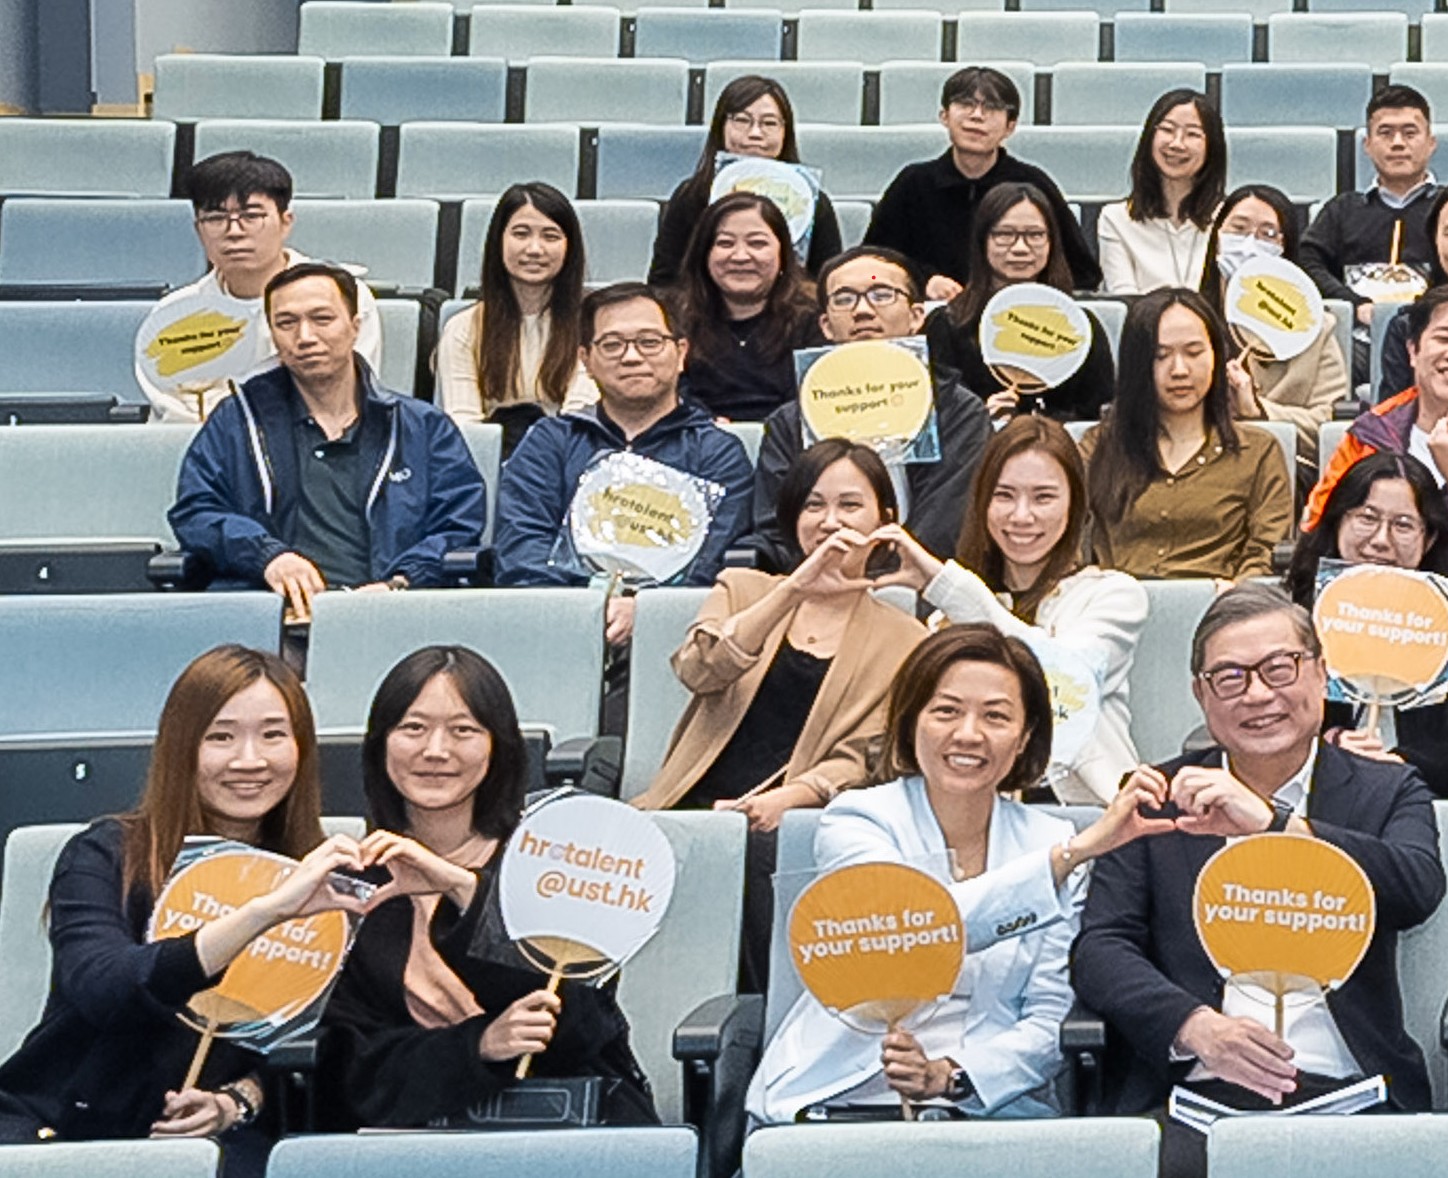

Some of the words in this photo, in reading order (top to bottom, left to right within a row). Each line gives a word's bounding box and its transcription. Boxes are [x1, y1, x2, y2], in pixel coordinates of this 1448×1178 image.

[811, 384, 863, 402] Thanks
[865, 382, 886, 394] for
[888, 379, 920, 394] your
[834, 398, 888, 415] support
[1336, 602, 1404, 626] Thanks
[1406, 610, 1434, 630] for
[1320, 615, 1365, 635] your
[1368, 622, 1448, 649] support!
[192, 891, 238, 920] Tha
[535, 870, 654, 914] @ust.hk
[1222, 882, 1309, 908] Thanks
[1312, 889, 1347, 912] for
[813, 912, 898, 939] Thanks
[902, 908, 935, 929] for
[1203, 902, 1260, 925] your
[1264, 908, 1366, 935] support!
[249, 933, 333, 971] pport!
[798, 938, 855, 965] your
[858, 923, 960, 955] support!
